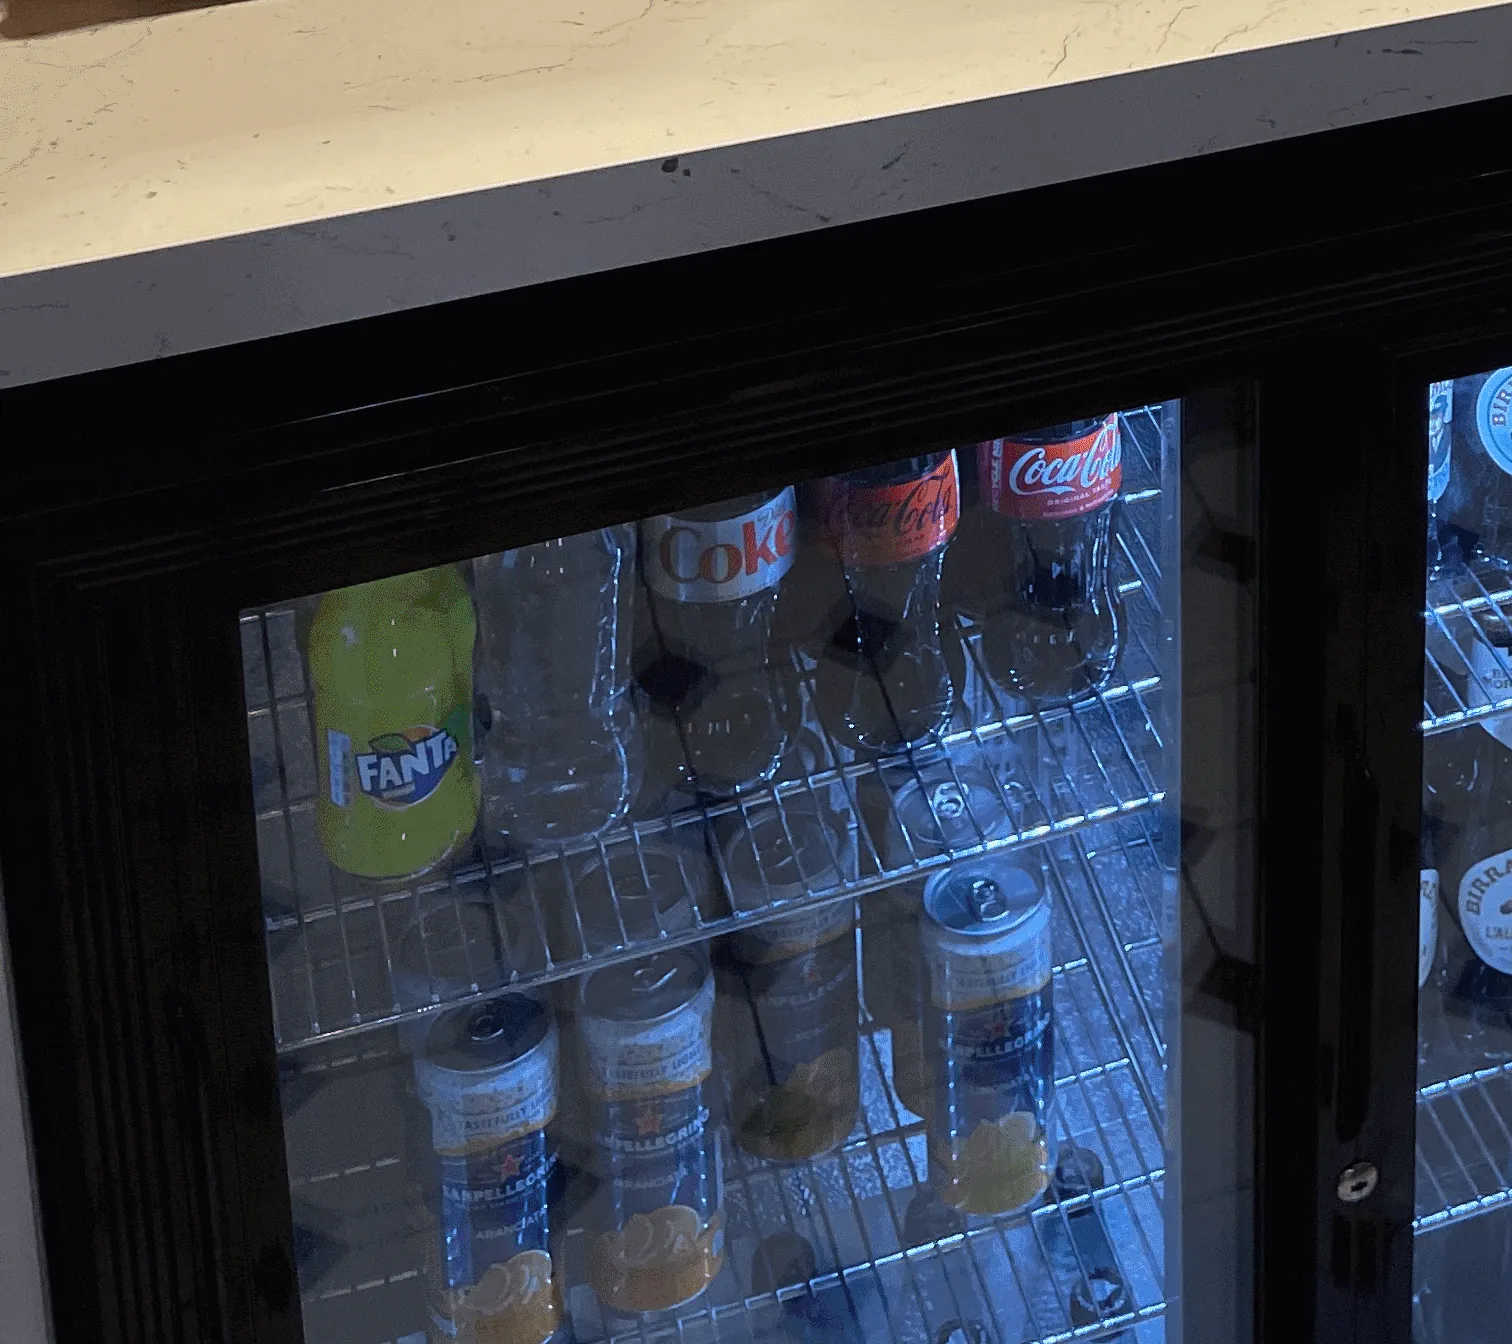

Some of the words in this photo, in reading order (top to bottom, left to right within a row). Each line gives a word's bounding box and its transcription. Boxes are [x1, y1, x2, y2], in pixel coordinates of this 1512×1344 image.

[1008, 422, 1122, 496] Coca-Cola
[658, 510, 795, 585] Coke
[356, 731, 459, 792] FANTA
